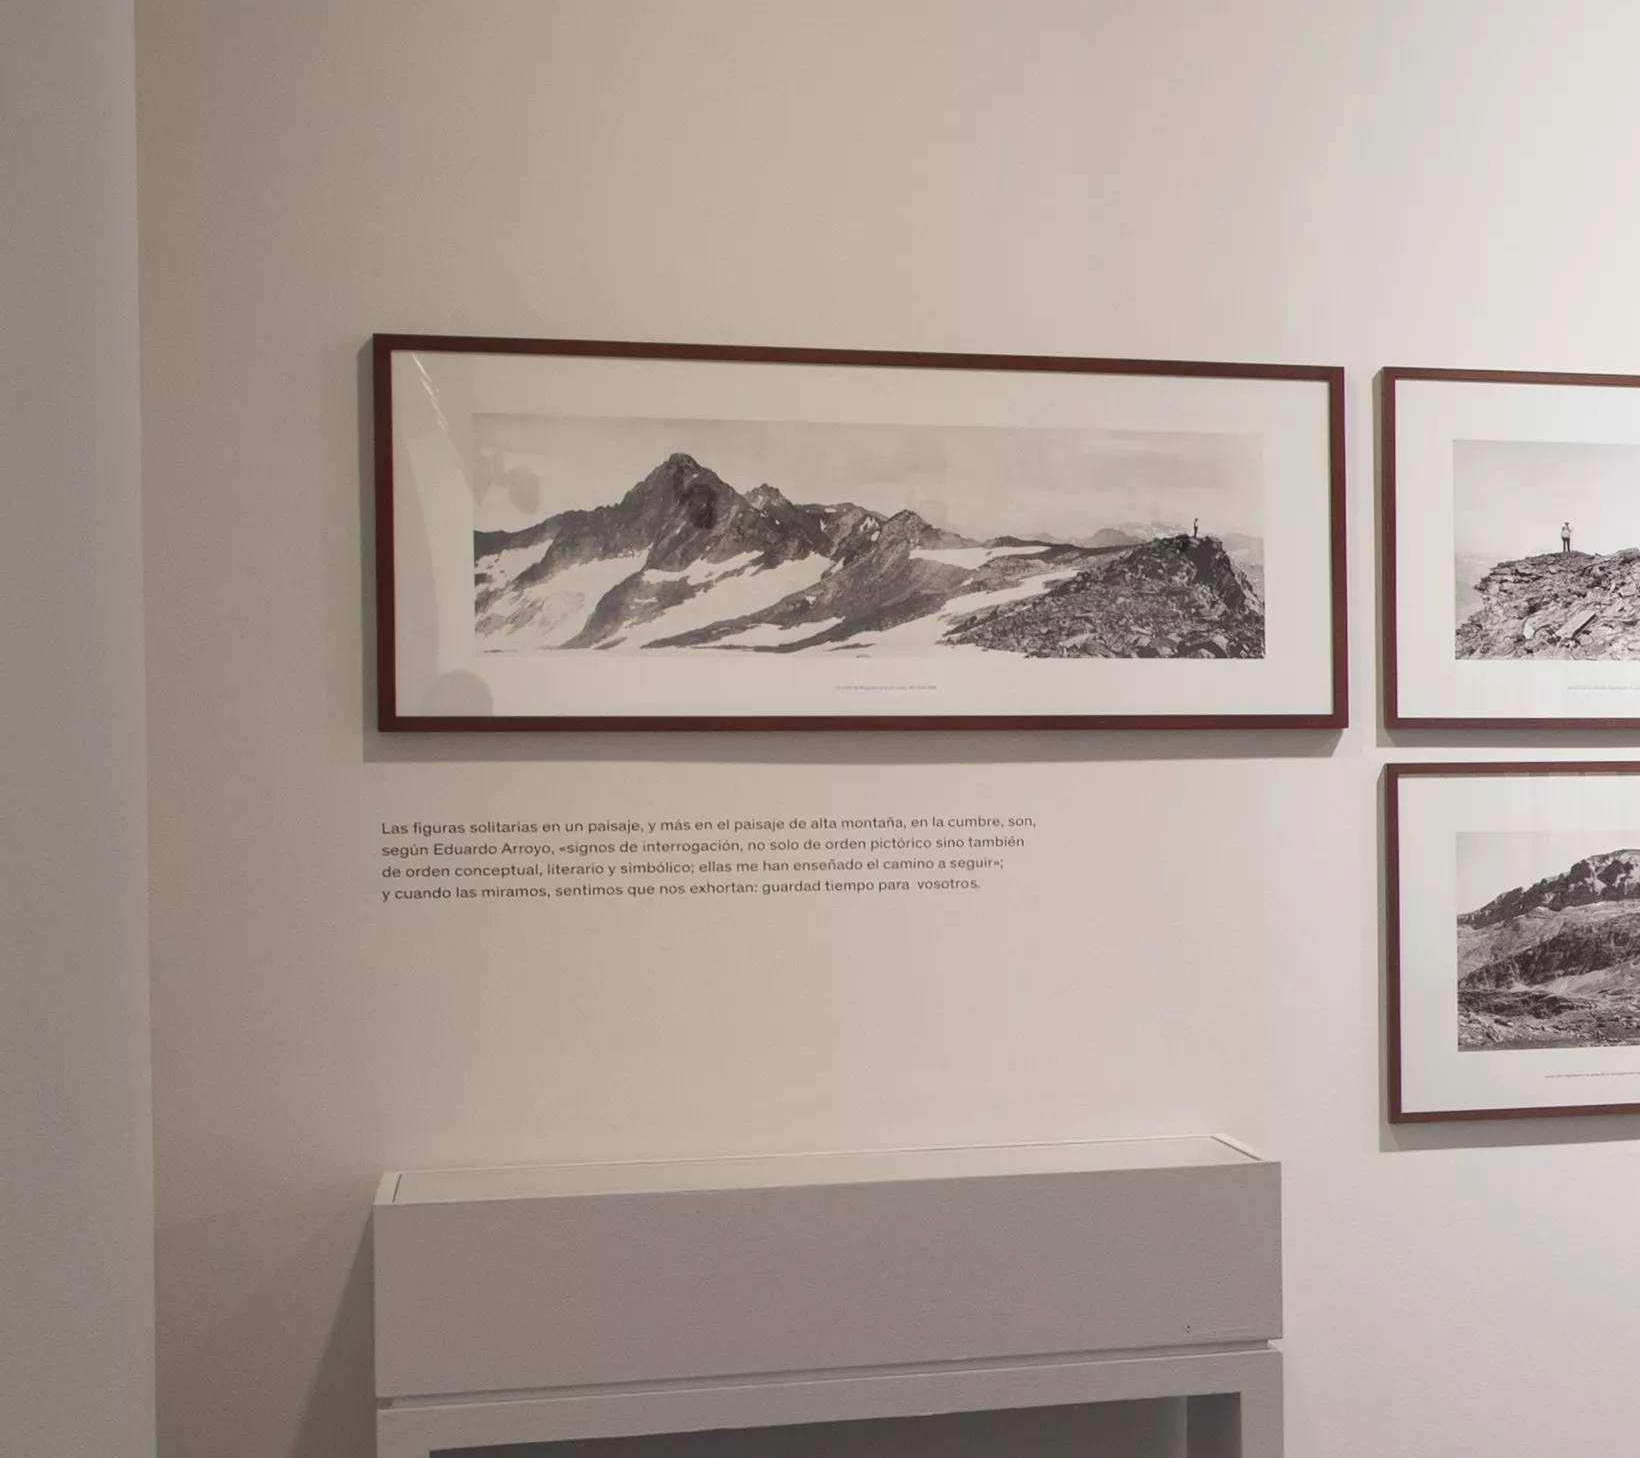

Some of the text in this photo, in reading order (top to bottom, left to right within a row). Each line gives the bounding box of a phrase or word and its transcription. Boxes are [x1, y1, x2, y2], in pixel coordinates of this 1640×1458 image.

[381, 815, 1037, 838] Las figuras solitarias en un paisaje, y más en el paisaje de alta montaña, en la cumbre, son,
[381, 835, 1025, 860] según Eduardo Arroyo, «signos de interrogación, no solo de orden pictórico sino también
[381, 856, 1004, 879] de orden conceptual, literario y simbólico; ellas me han enseñado el camino a seguir»;
[381, 878, 981, 903] y cuando las miramos, sentimos que nos exhortan: guardad tiempo para vosotros.
